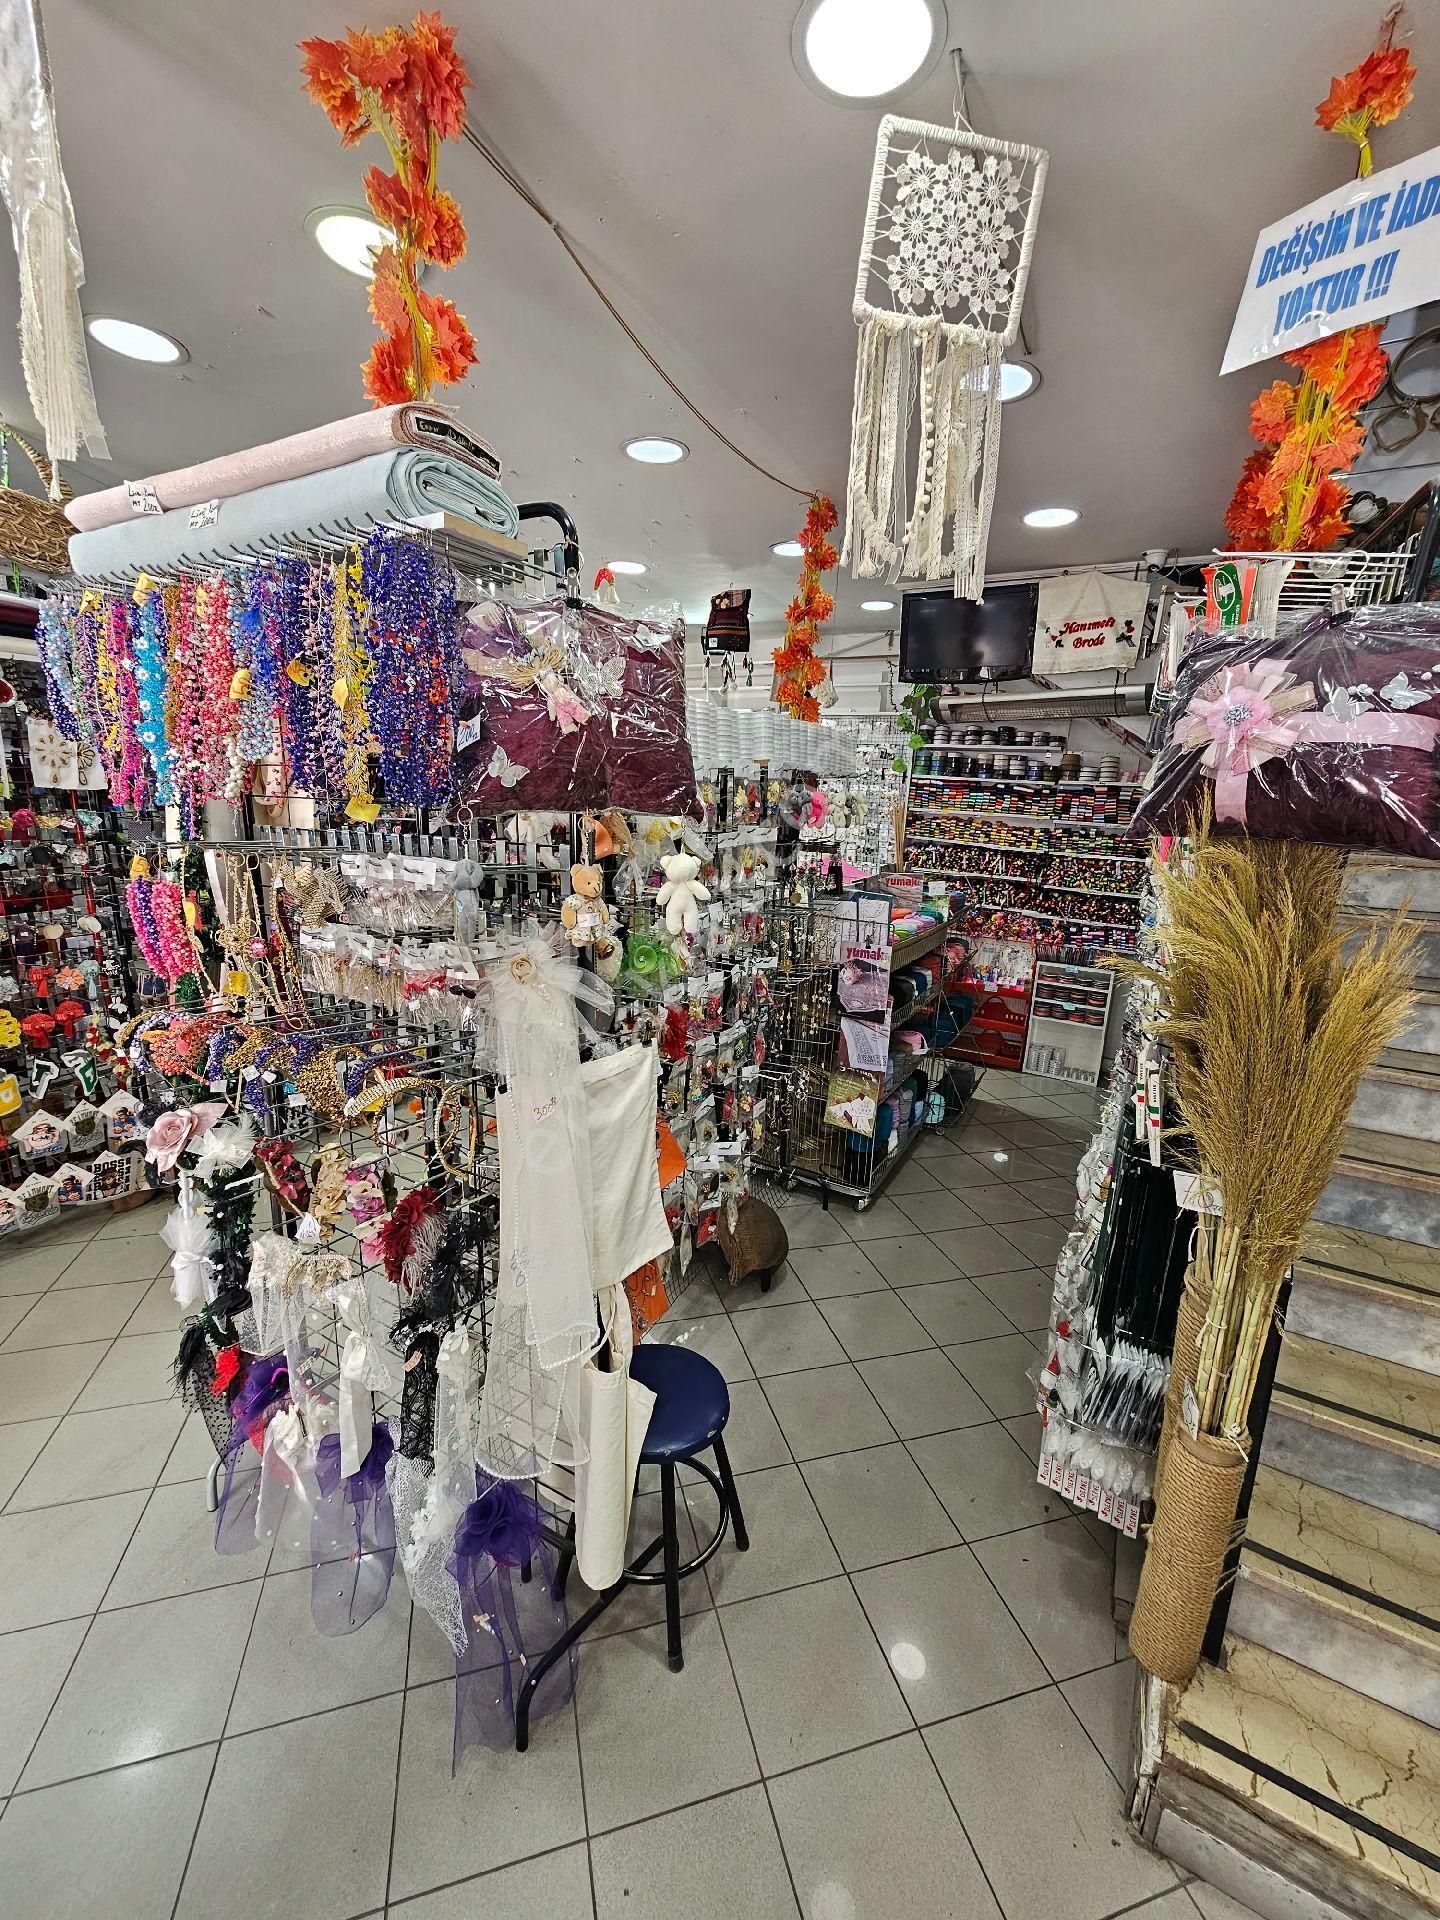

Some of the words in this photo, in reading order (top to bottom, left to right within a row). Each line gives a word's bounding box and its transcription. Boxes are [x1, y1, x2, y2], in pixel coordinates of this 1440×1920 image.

[1256, 210, 1355, 289] DEĞİŞİM
[1354, 193, 1390, 249] VE
[1273, 264, 1366, 336] YOKTUR
[1364, 249, 1400, 301] !!!
